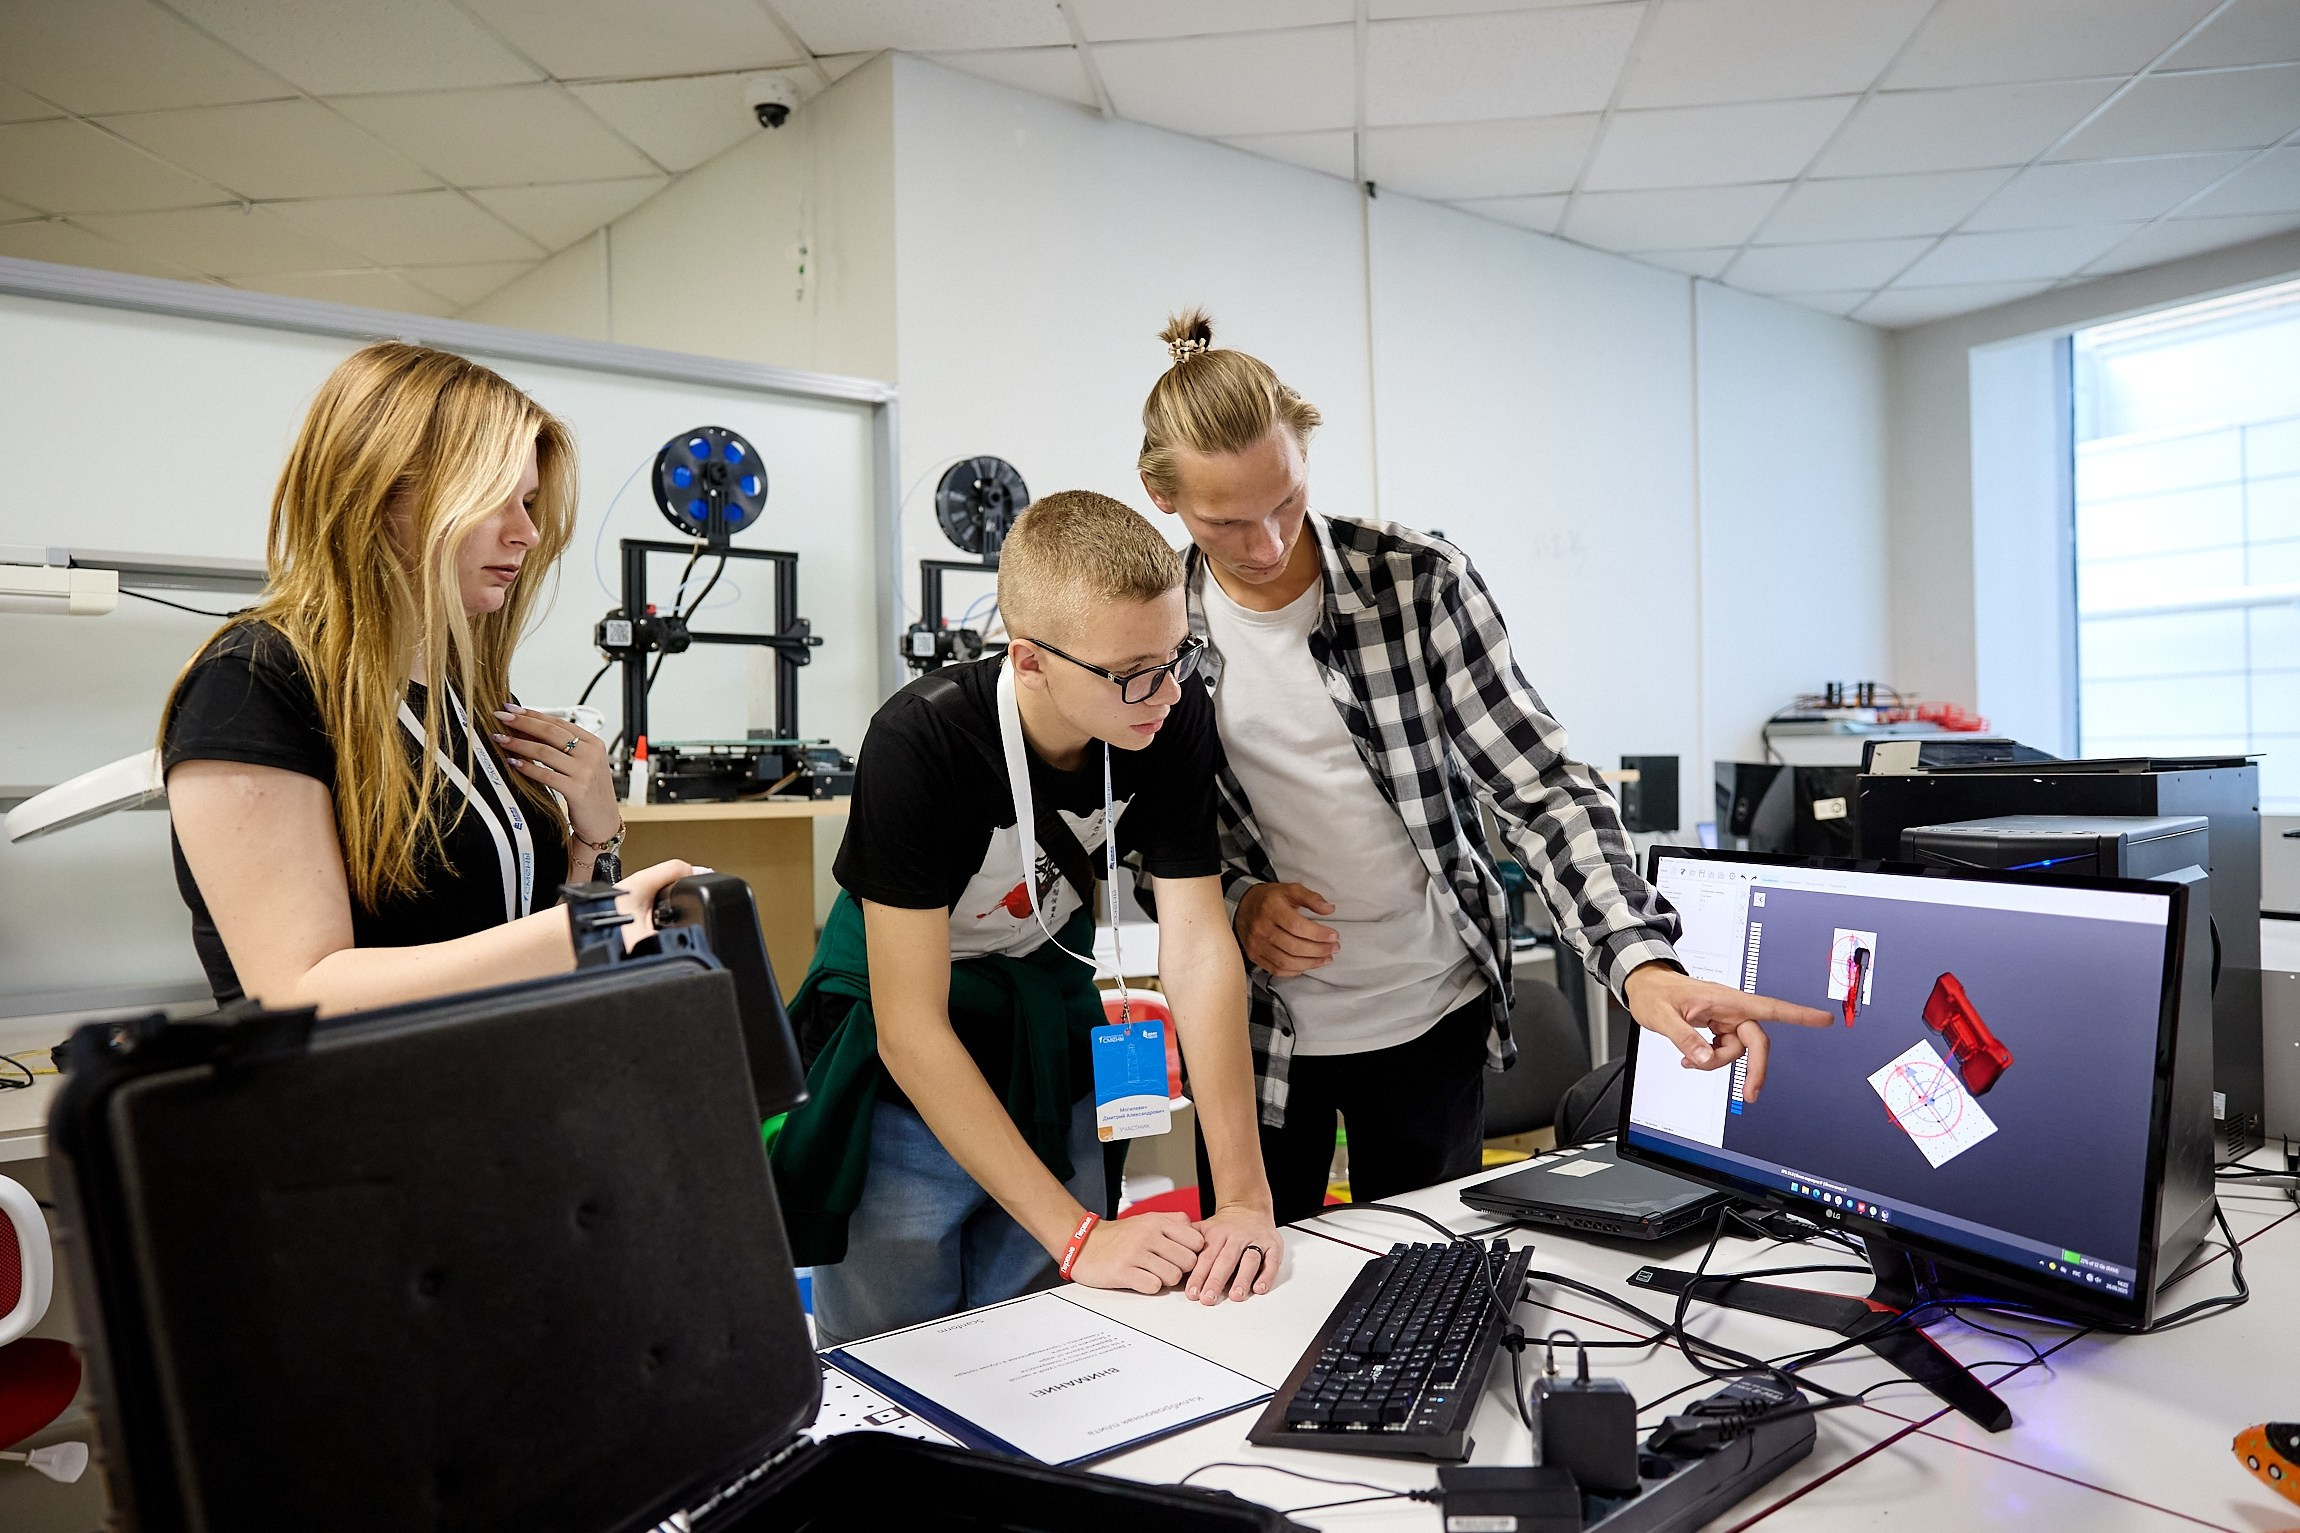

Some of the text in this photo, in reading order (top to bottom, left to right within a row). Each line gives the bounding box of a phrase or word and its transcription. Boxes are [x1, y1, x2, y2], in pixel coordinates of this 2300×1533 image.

[1102, 1109, 1165, 1122] Дмитрий Александрович
[1119, 1123, 1151, 1132] УЧАСТНИК
[1832, 1211, 1841, 1220] LG
[1074, 1216, 1093, 1240] Первые
[1060, 1246, 1076, 1274] Первые
[937, 1318, 984, 1334] Scanform
[1029, 1367, 1120, 1397] ВНИМАНИЕ!
[1085, 1395, 1204, 1436] Калибровочная плита
